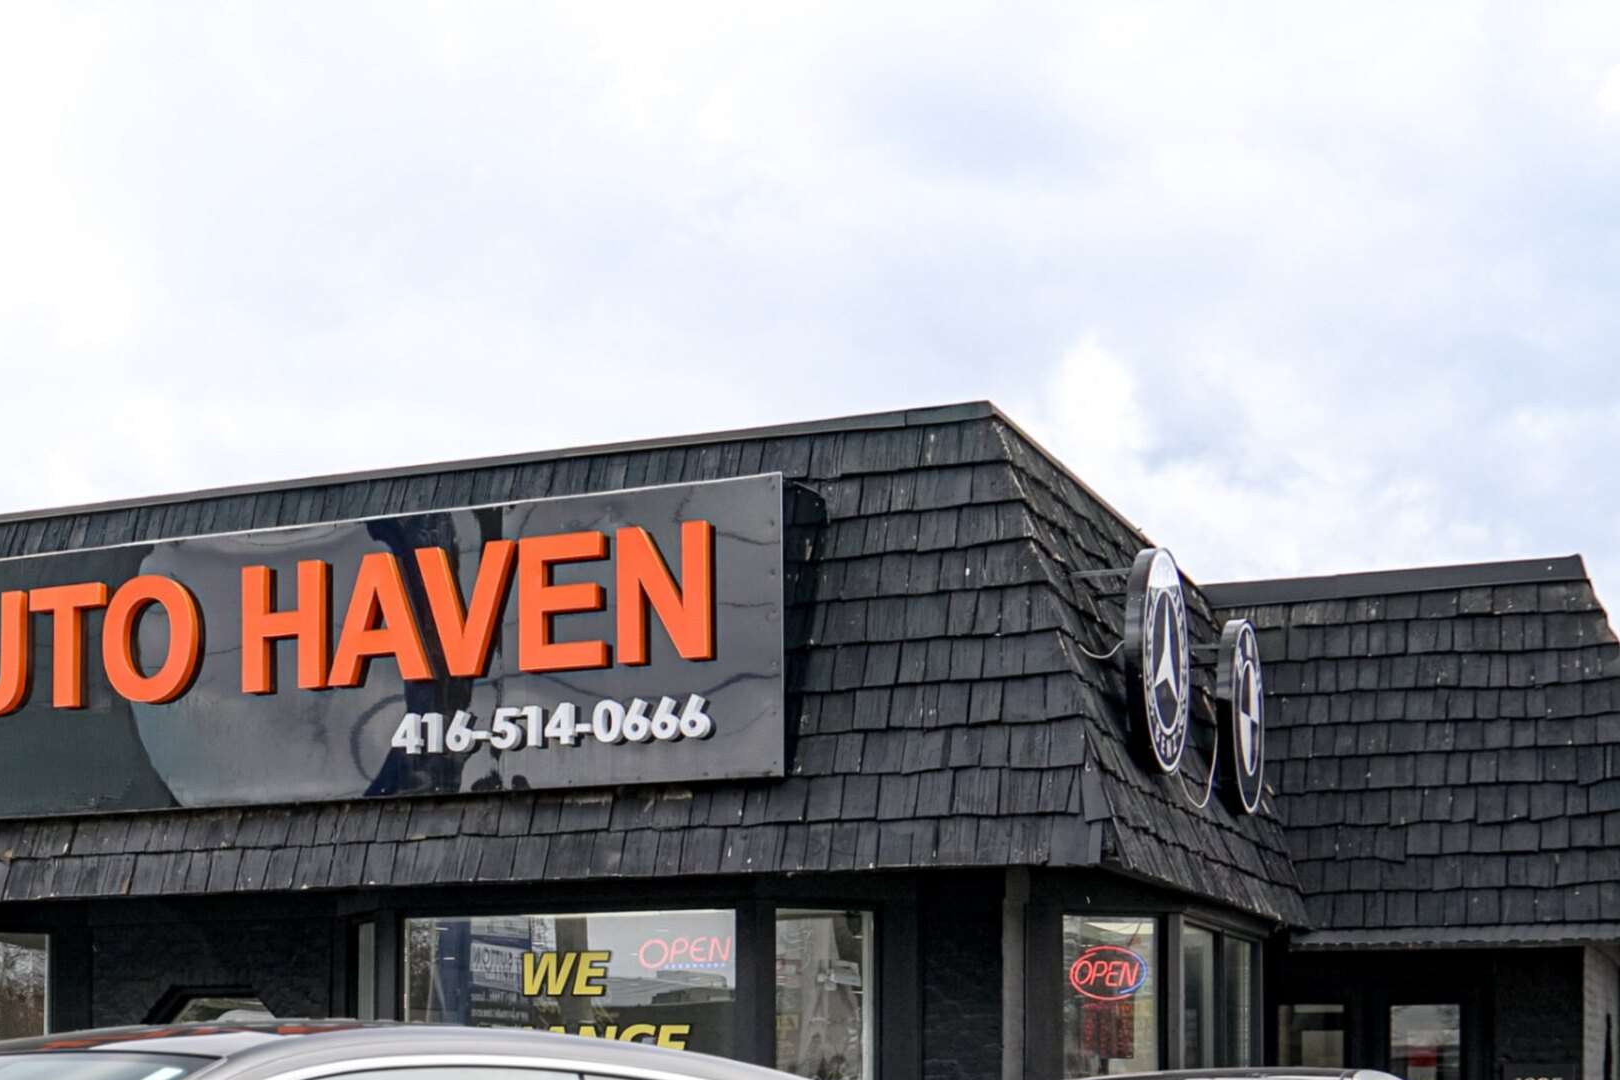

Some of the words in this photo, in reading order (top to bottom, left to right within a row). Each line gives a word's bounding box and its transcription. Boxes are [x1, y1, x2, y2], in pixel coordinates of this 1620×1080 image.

[241, 520, 714, 694] HAVEN
[391, 694, 712, 755] 416-514-0666
[522, 952, 611, 996] WE
[638, 936, 732, 970] OPEN
[1074, 960, 1140, 987] OPEN
